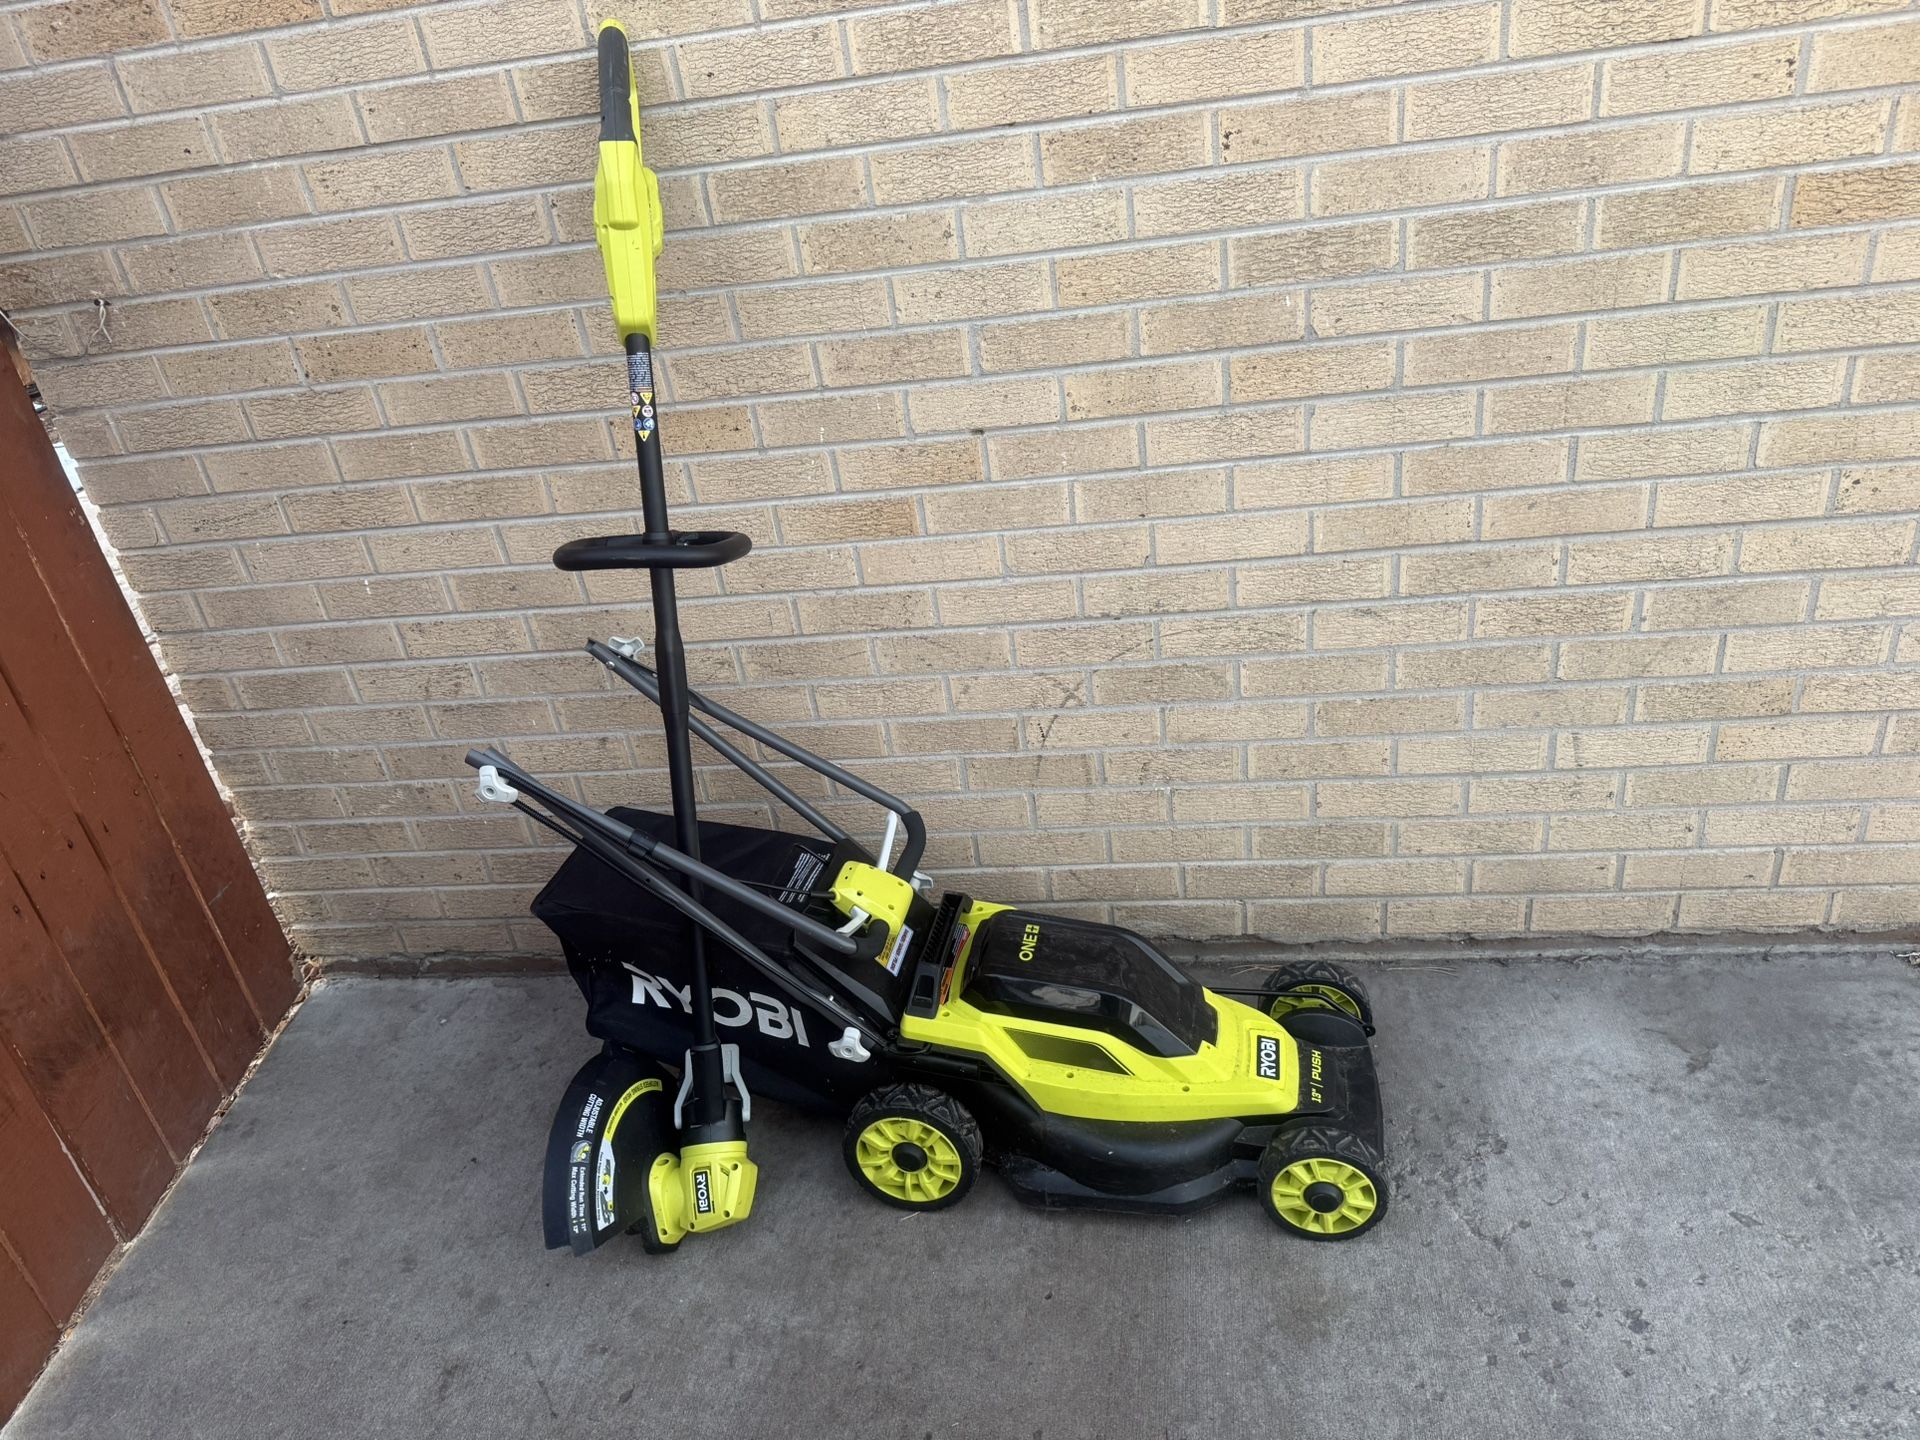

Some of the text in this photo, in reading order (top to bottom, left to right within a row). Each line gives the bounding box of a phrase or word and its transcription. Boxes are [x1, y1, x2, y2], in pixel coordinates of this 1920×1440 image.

[621, 960, 810, 1048] RYOBI
[1261, 1037, 1276, 1077] RYOBI
[1311, 1049, 1322, 1081] PUSH
[1311, 1088, 1322, 1104] 13"
[576, 1093, 597, 1138] CUTTING WIDTH
[585, 1096, 604, 1134] ADJUSTABLE
[569, 1179, 577, 1200] Cutting
[571, 1166, 579, 1179] Max
[578, 1166, 587, 1191] Extended
[696, 1174, 709, 1213] RYOBI
